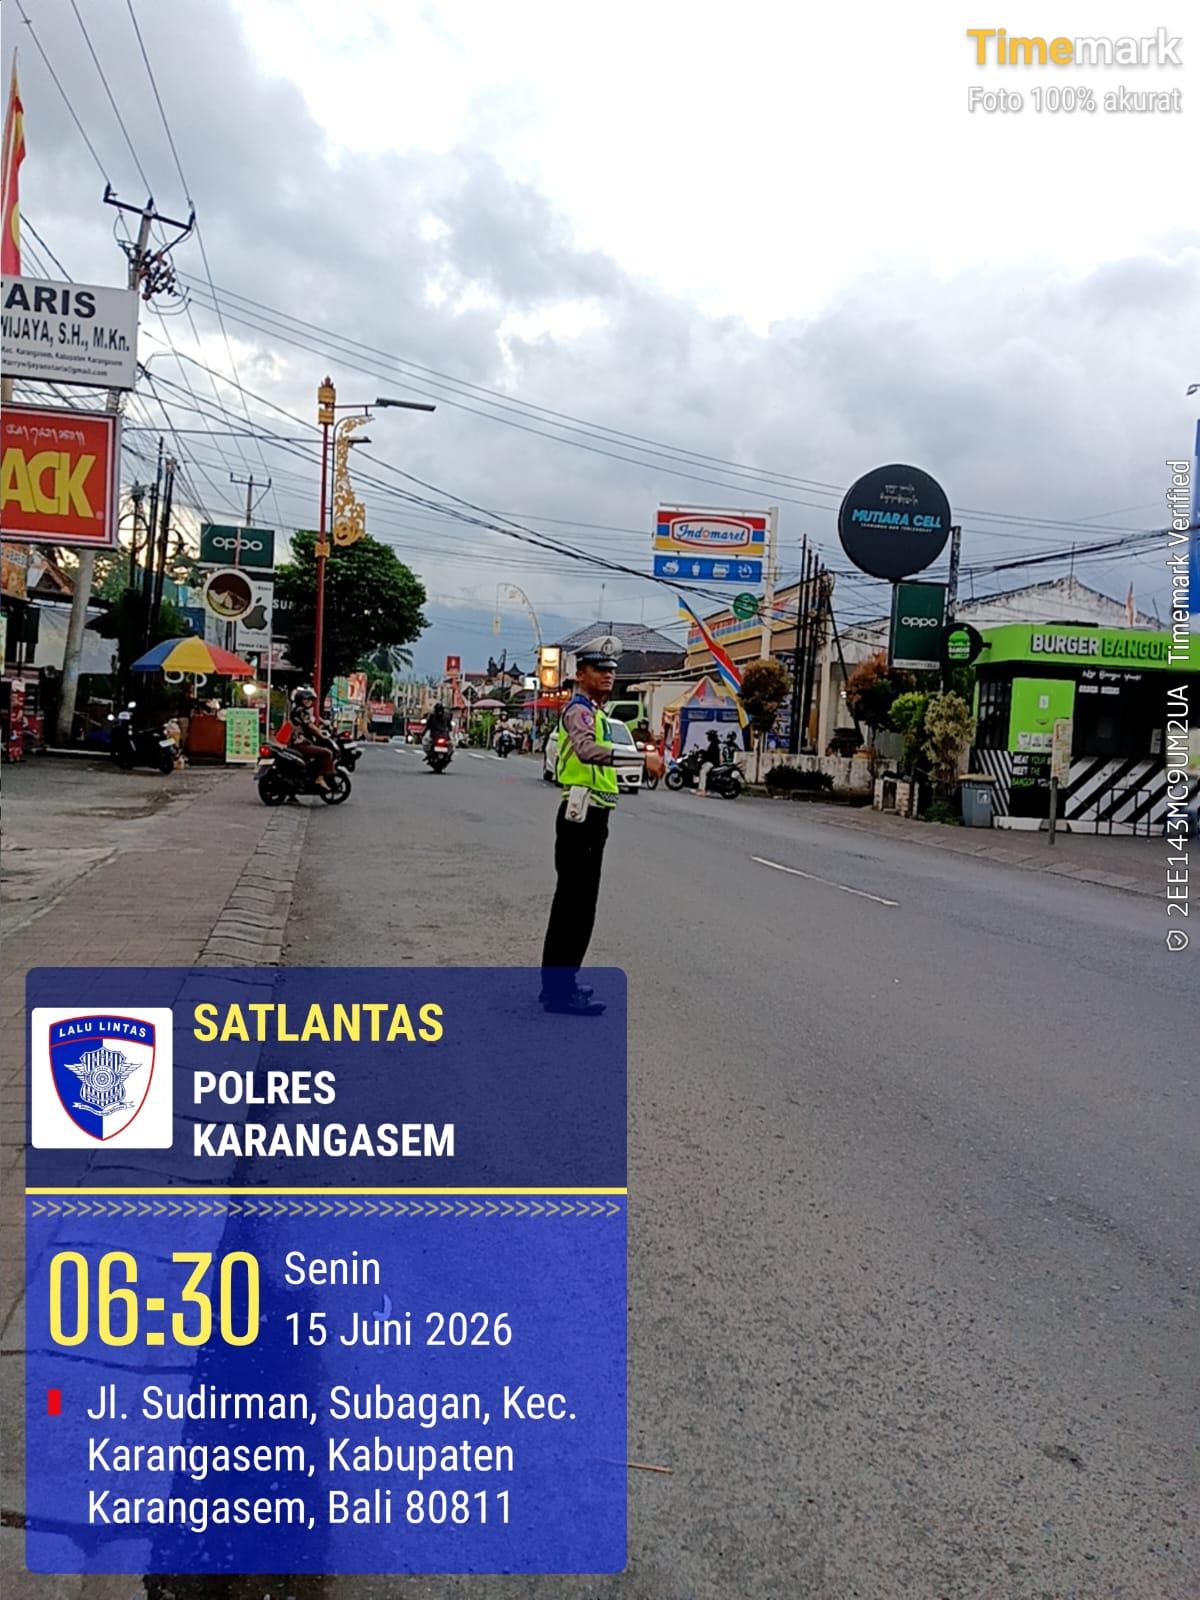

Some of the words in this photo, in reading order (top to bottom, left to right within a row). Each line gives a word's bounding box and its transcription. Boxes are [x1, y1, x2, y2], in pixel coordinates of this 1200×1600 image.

[0, 281, 96, 319] ARIS
[58, 321, 89, 352] S.H.,
[92, 326, 130, 352] M.Kn.
[852, 509, 909, 526] MUTIARA
[913, 515, 942, 529] CELL
[676, 524, 745, 541] Indomaret
[212, 536, 263, 551] oppo
[901, 616, 938, 628] oppo
[1031, 634, 1099, 656] BURGER
